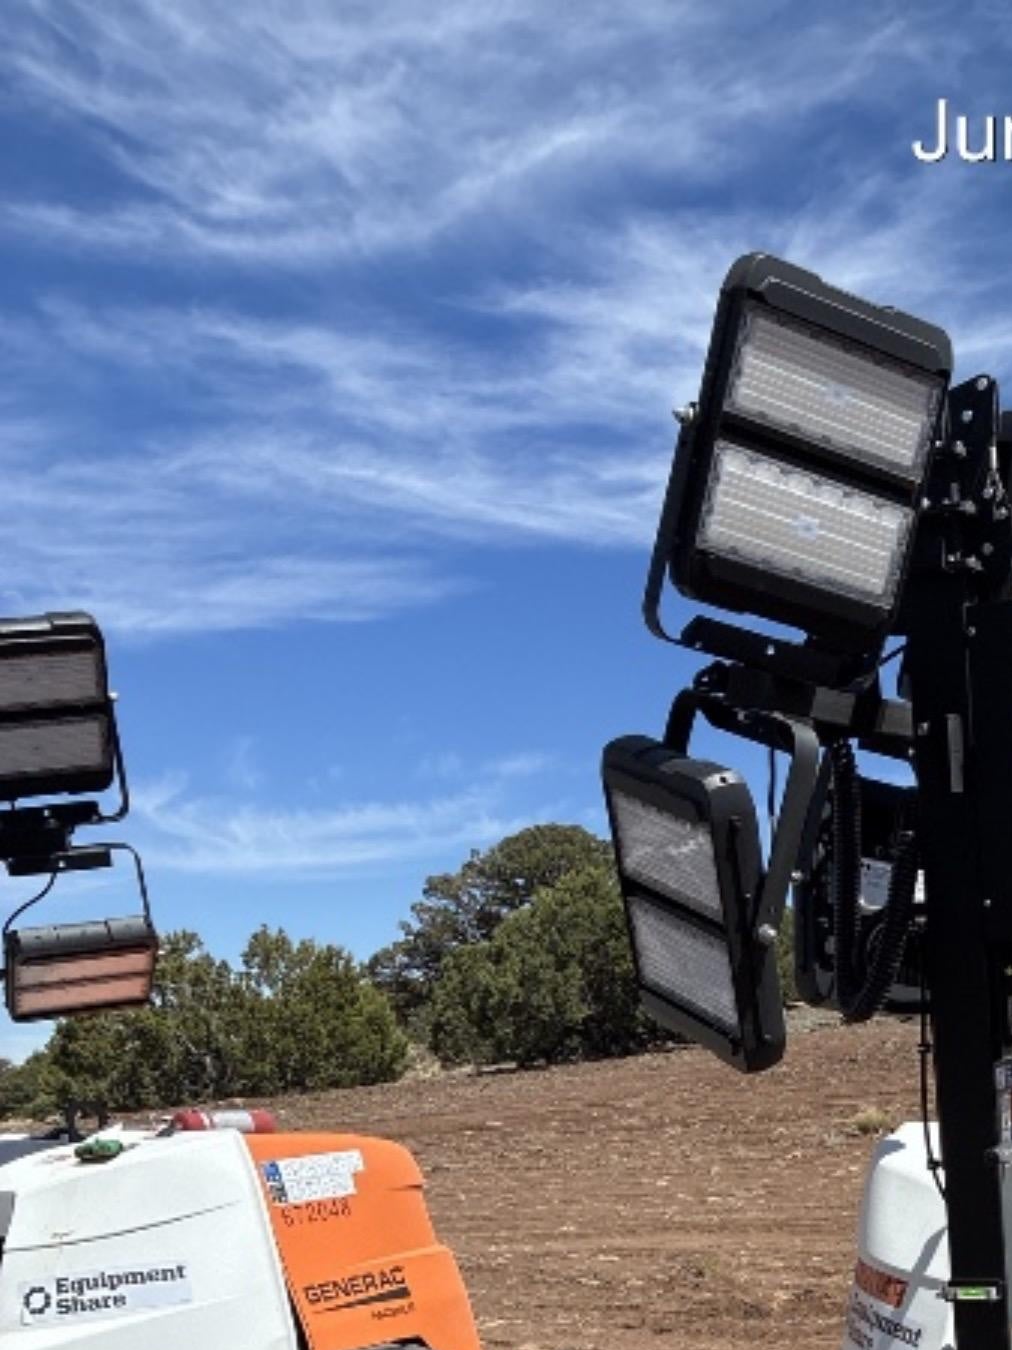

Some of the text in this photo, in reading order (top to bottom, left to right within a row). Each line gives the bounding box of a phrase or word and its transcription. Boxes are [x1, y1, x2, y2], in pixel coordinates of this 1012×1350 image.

[55, 1264, 187, 1296] Equipment
[303, 1265, 406, 1305] GENERAC
[55, 1293, 128, 1315] Share
